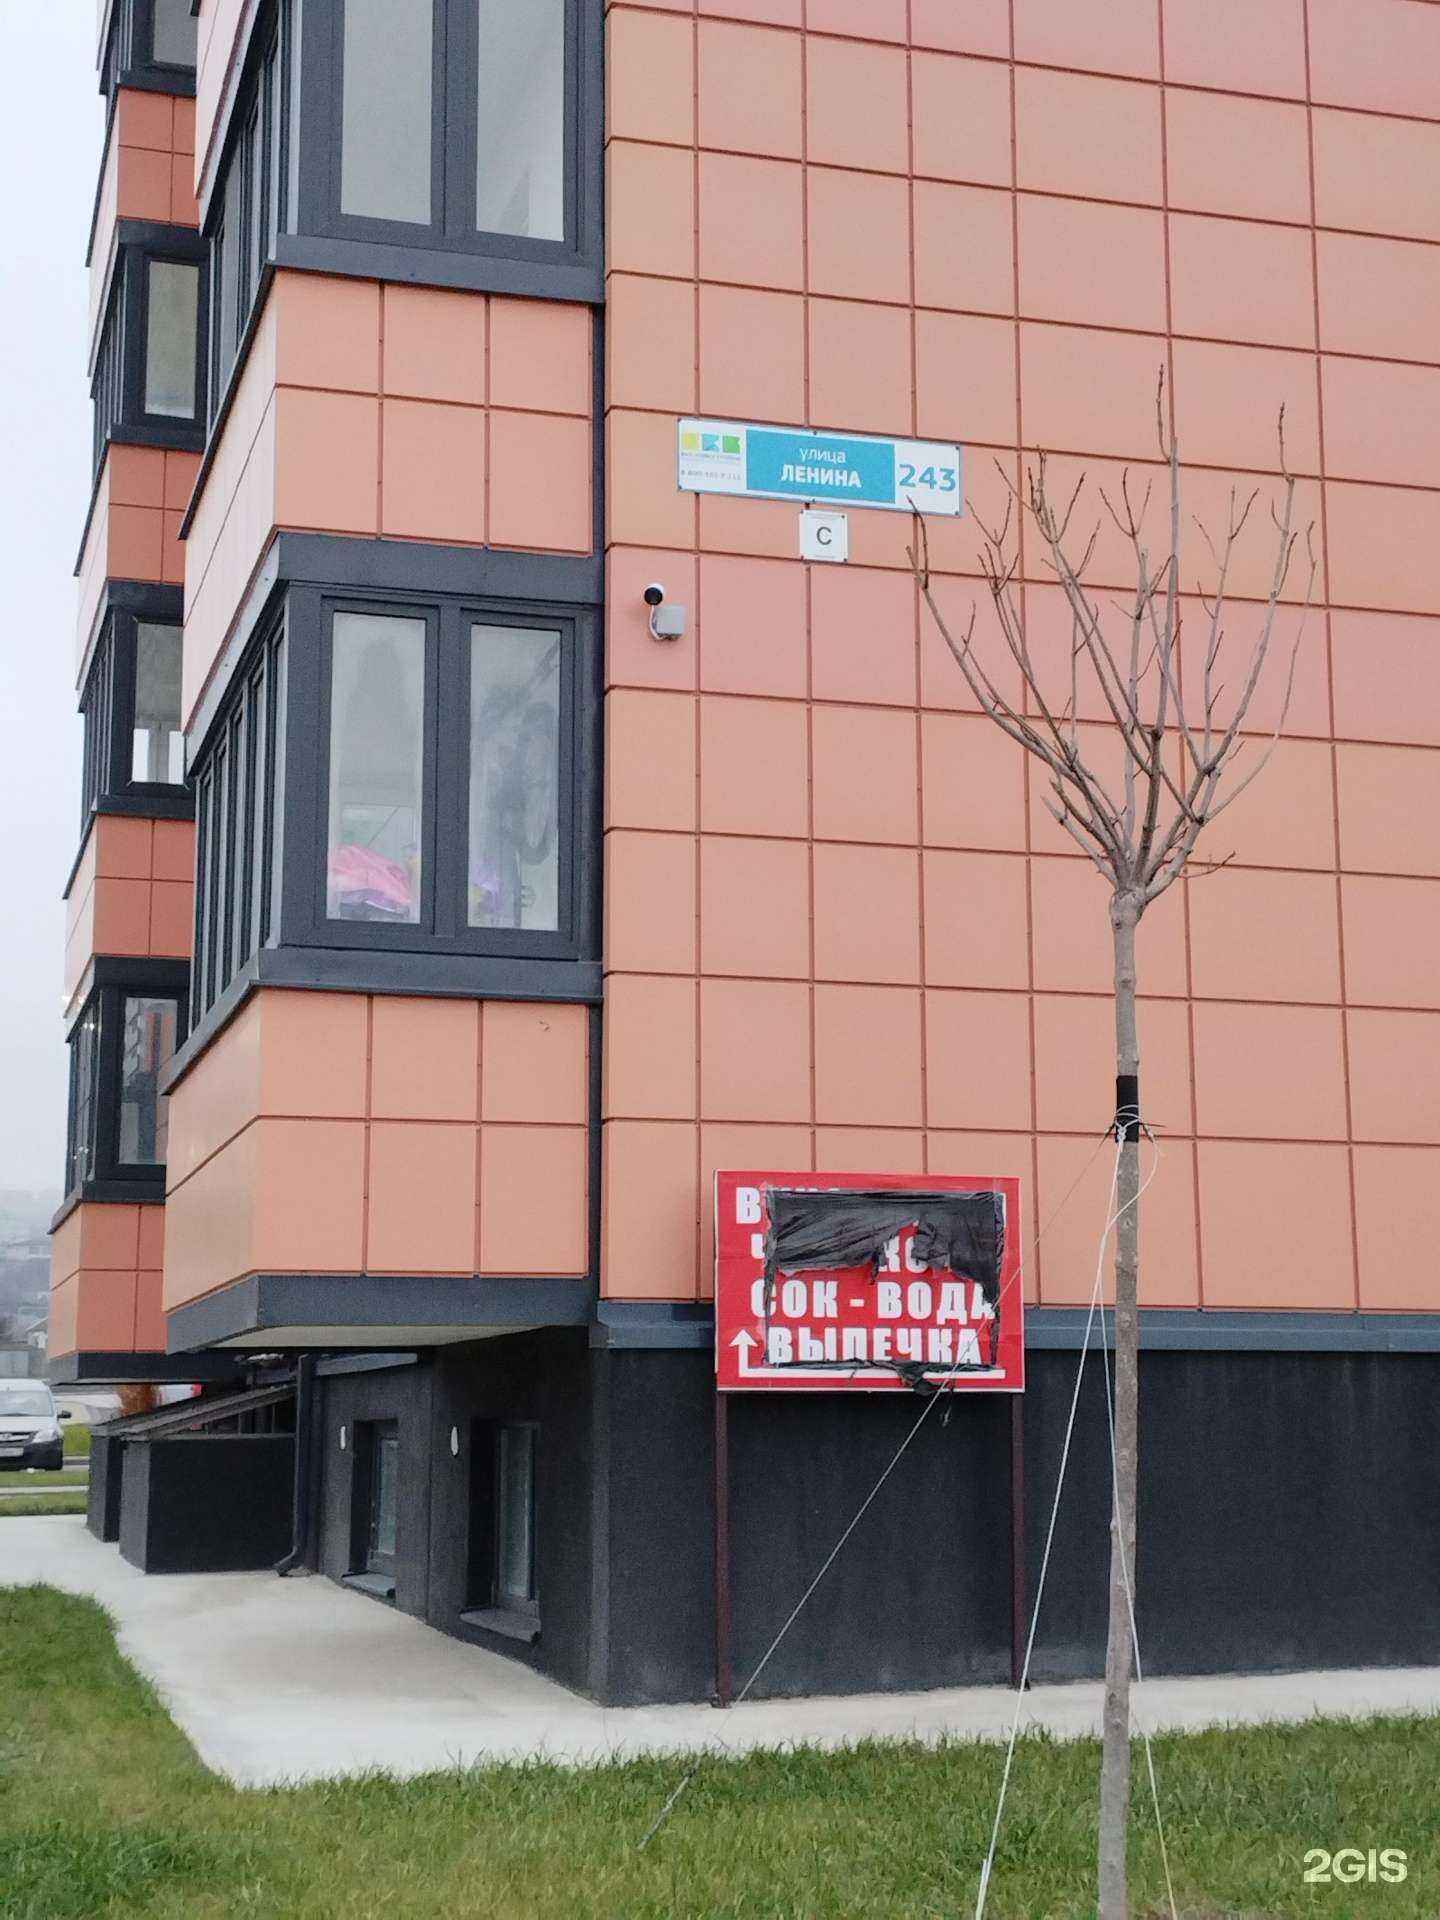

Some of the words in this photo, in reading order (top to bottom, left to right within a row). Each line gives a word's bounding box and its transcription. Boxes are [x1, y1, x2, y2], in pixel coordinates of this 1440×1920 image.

[798, 447, 846, 464] улица
[780, 463, 863, 489] ЛЕНИНА
[898, 463, 957, 493] 243
[750, 1278, 839, 1319] СОК
[767, 1326, 983, 1366] ВЫПЕЧКА
